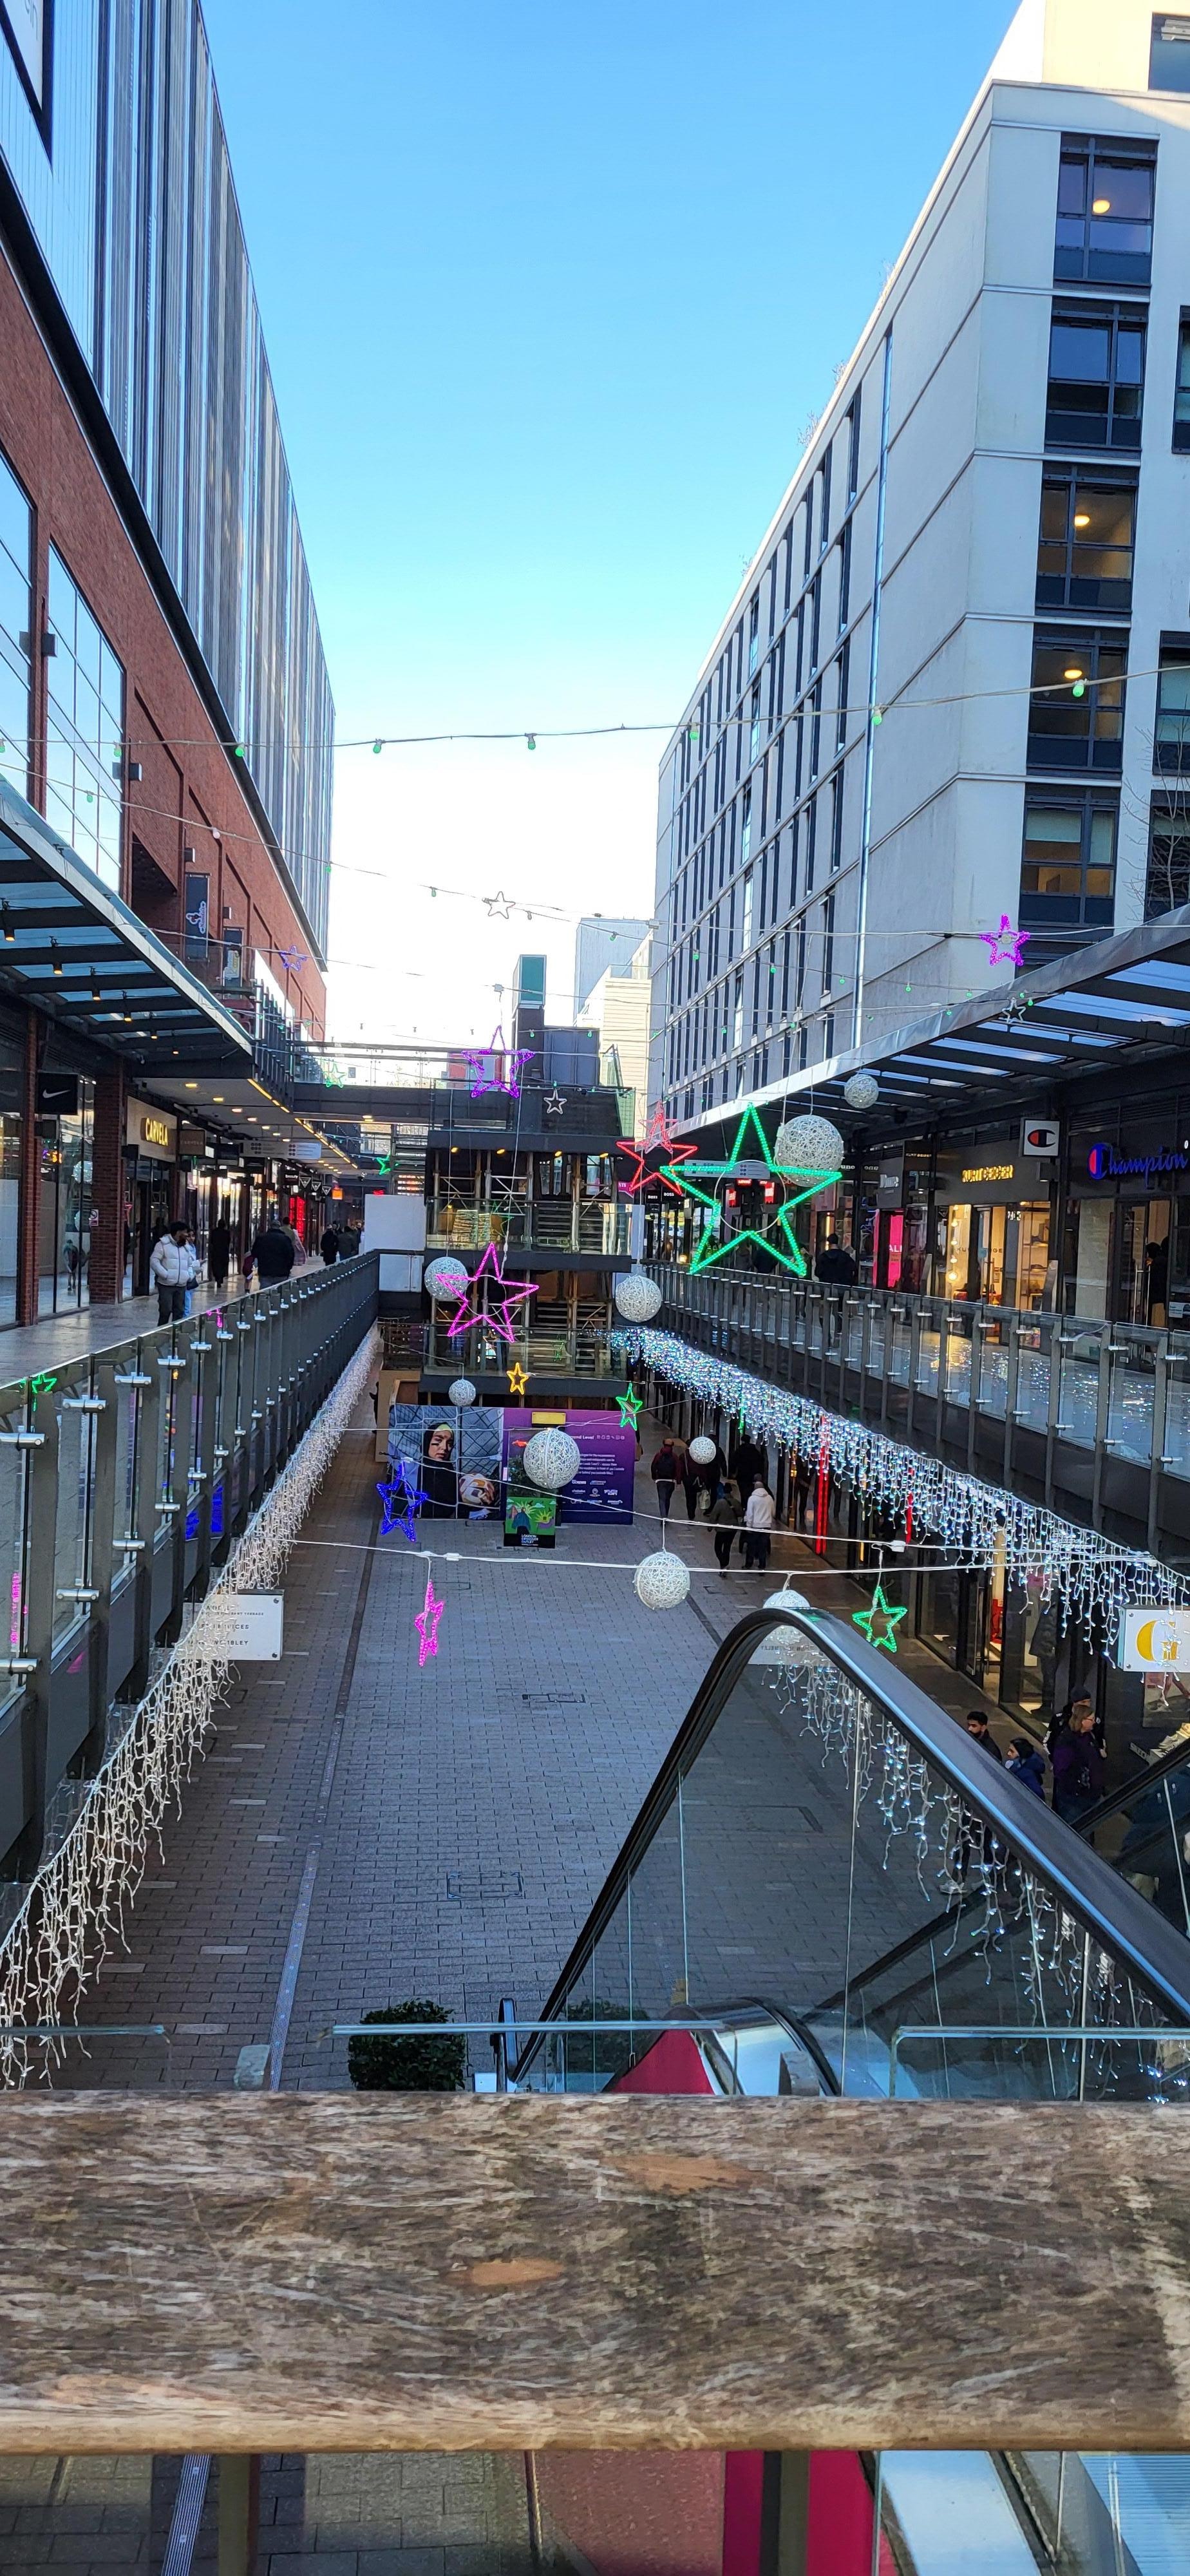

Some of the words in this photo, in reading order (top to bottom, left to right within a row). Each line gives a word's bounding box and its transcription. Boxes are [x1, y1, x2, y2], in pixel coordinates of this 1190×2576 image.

[146, 1117, 168, 1146] CARVELA
[1088, 1142, 1189, 1190] Champion
[889, 1244, 902, 1253] AL
